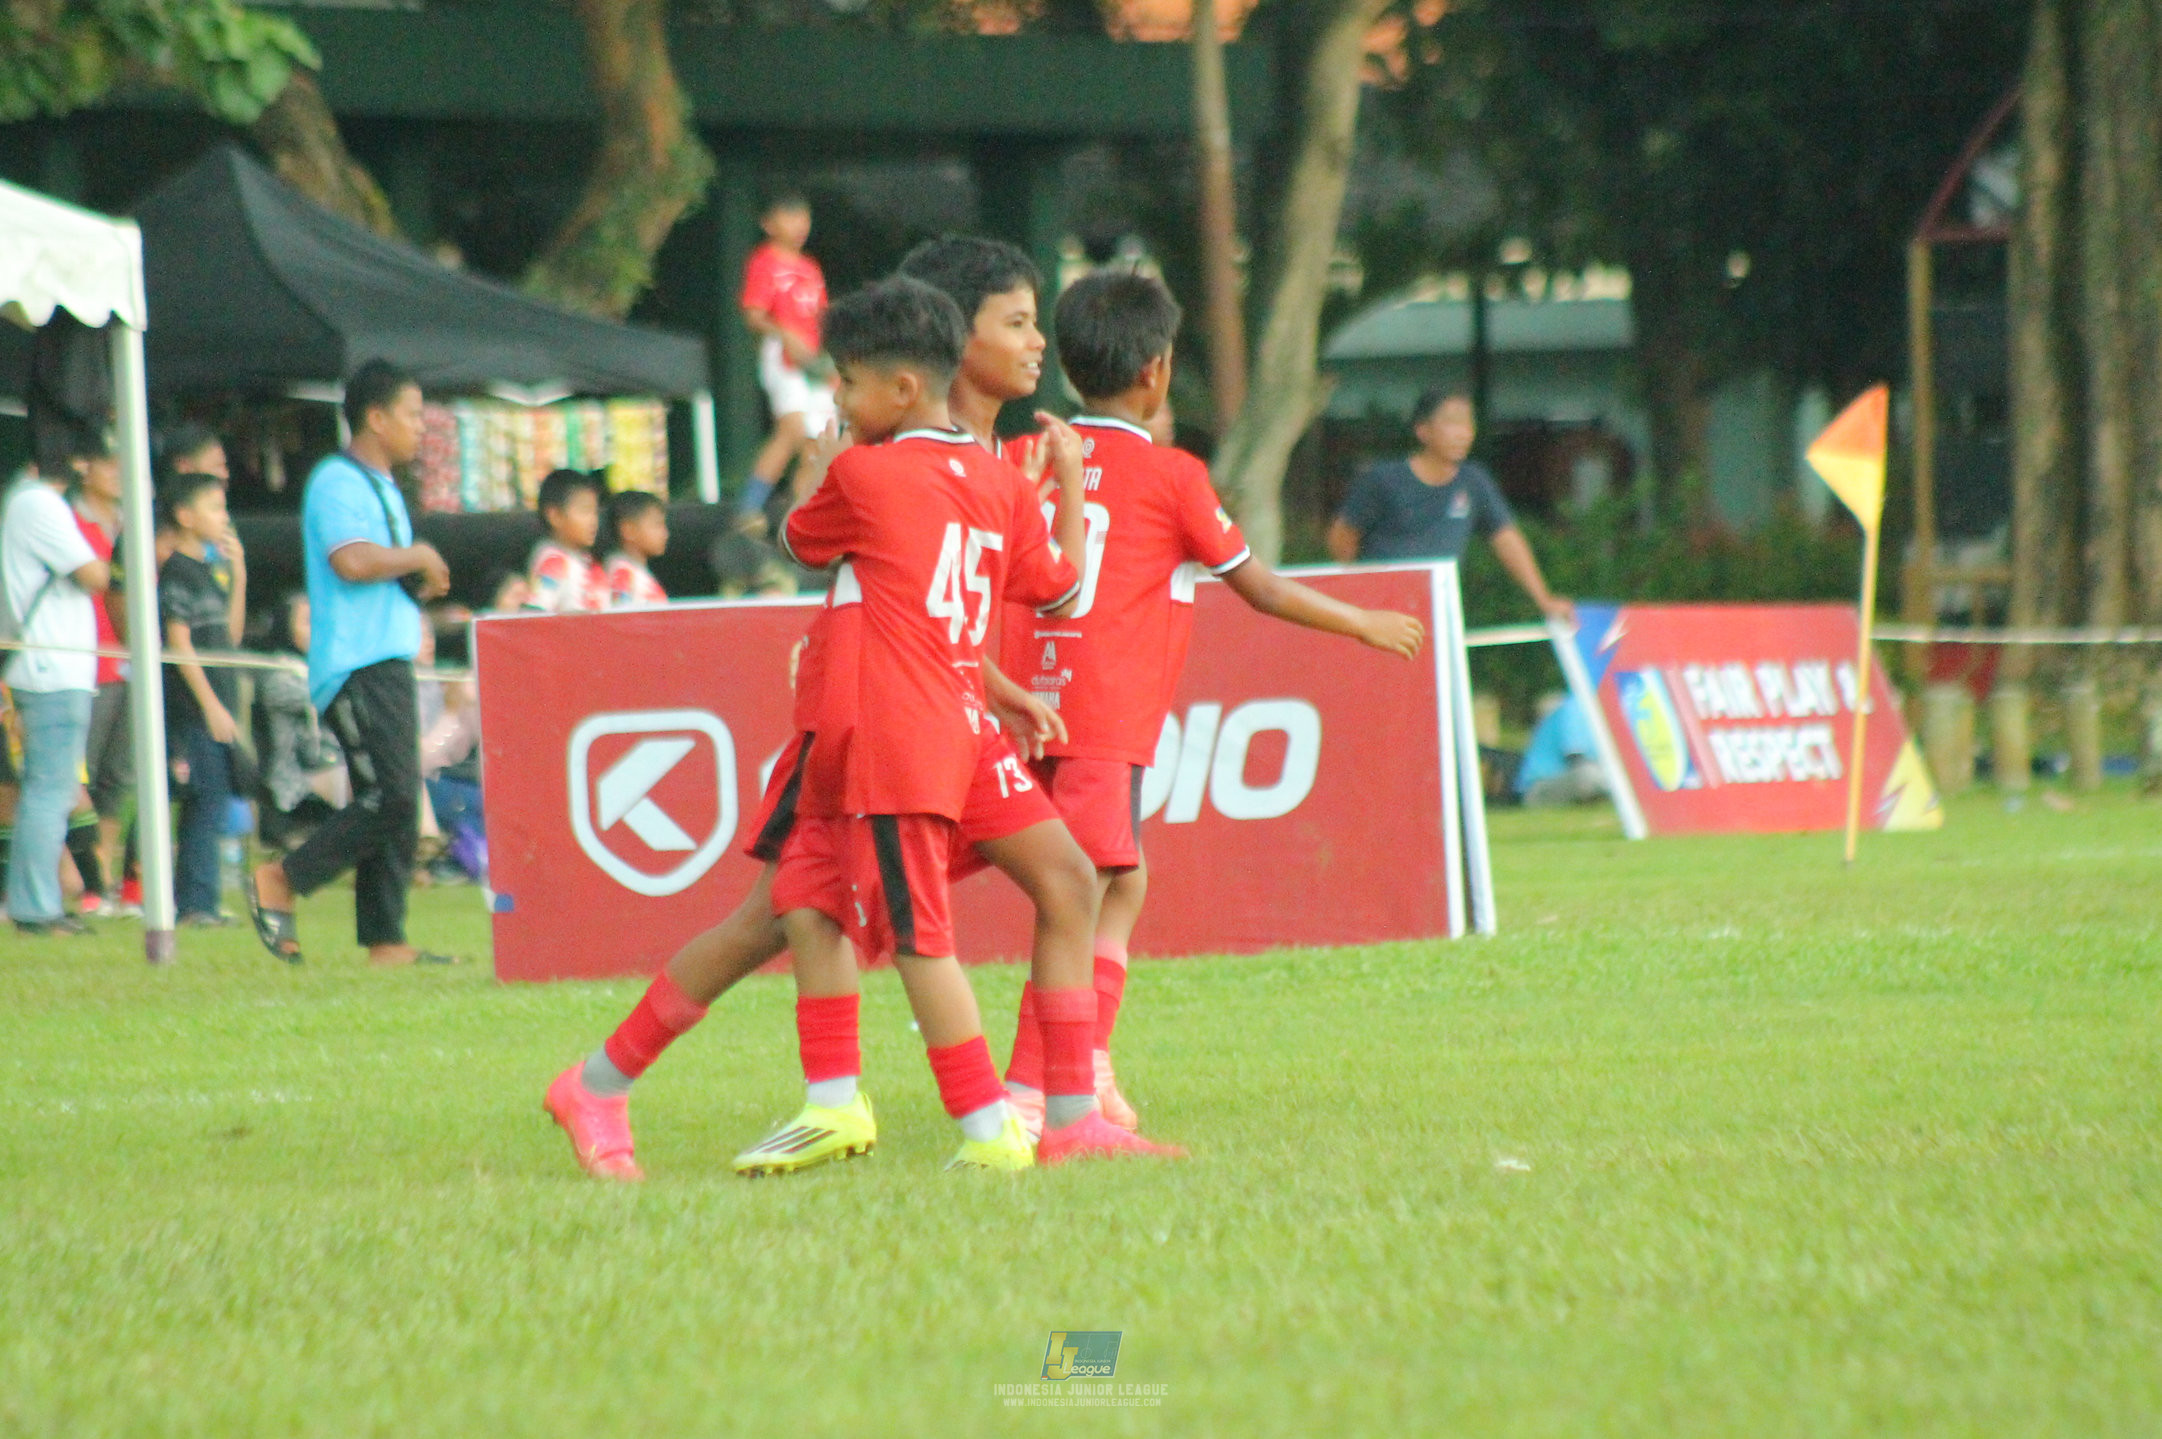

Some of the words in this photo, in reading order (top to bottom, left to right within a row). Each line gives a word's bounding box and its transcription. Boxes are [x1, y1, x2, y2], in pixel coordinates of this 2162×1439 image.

[925, 522, 1003, 646] 45
[1683, 660, 1761, 719] FAIR
[1755, 660, 1838, 717] PLAY
[993, 756, 1033, 798] 13
[1709, 724, 1843, 783] RESPECT
